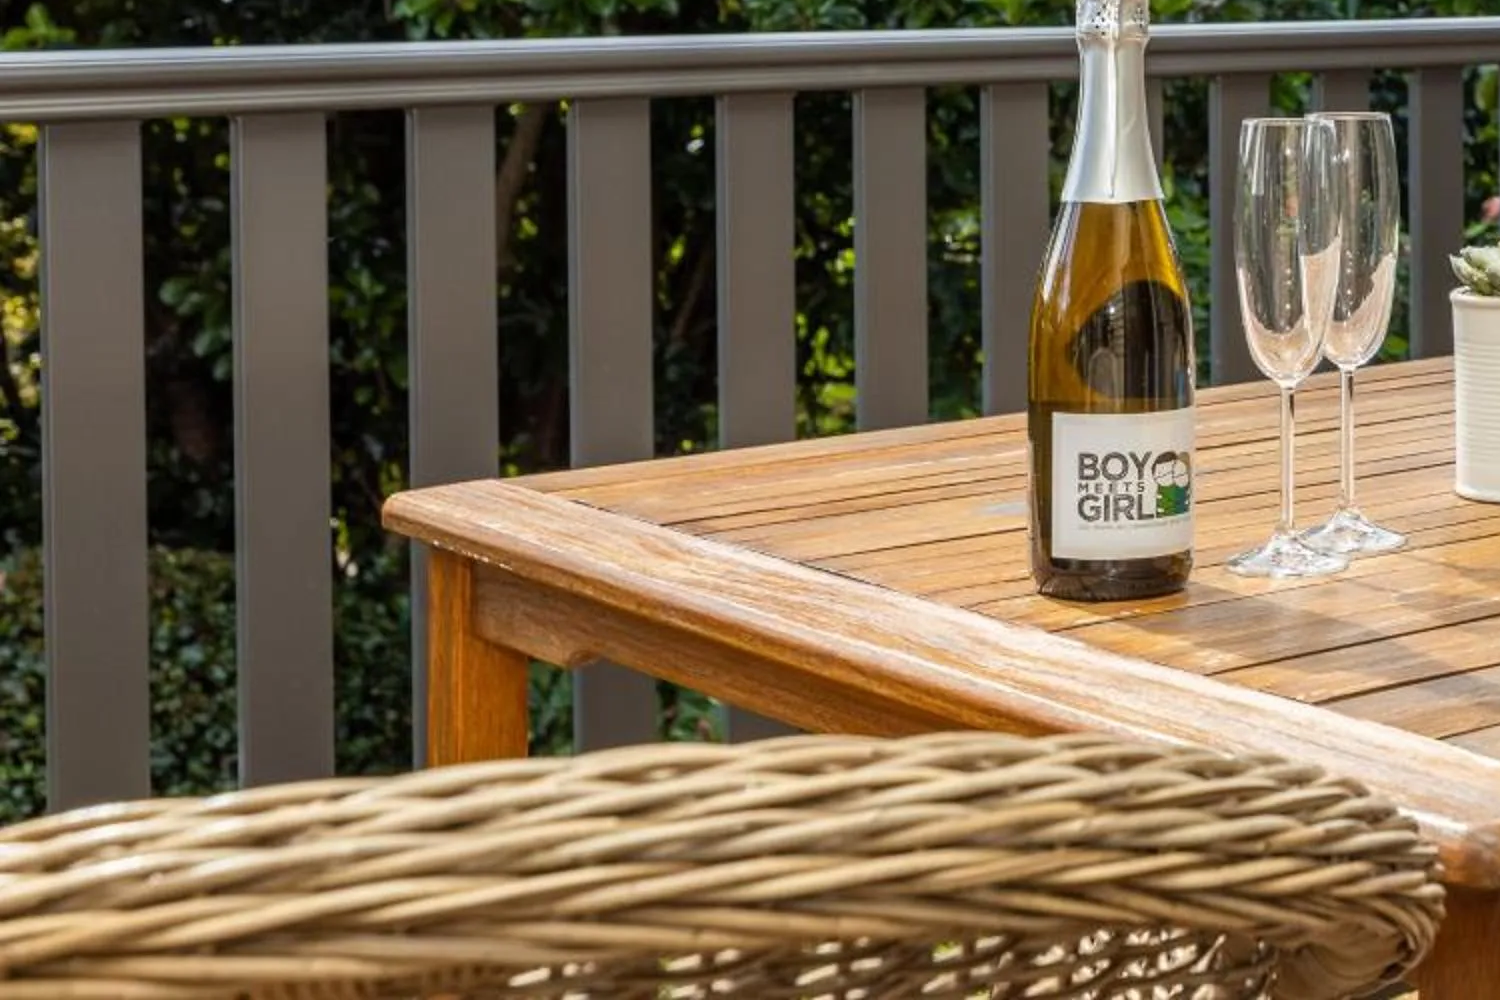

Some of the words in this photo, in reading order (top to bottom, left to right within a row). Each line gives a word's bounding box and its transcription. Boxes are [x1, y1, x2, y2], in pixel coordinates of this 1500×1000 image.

[1078, 452, 1152, 481] BOY
[1078, 482, 1145, 493] MEETS
[1078, 494, 1154, 522] GIRL
